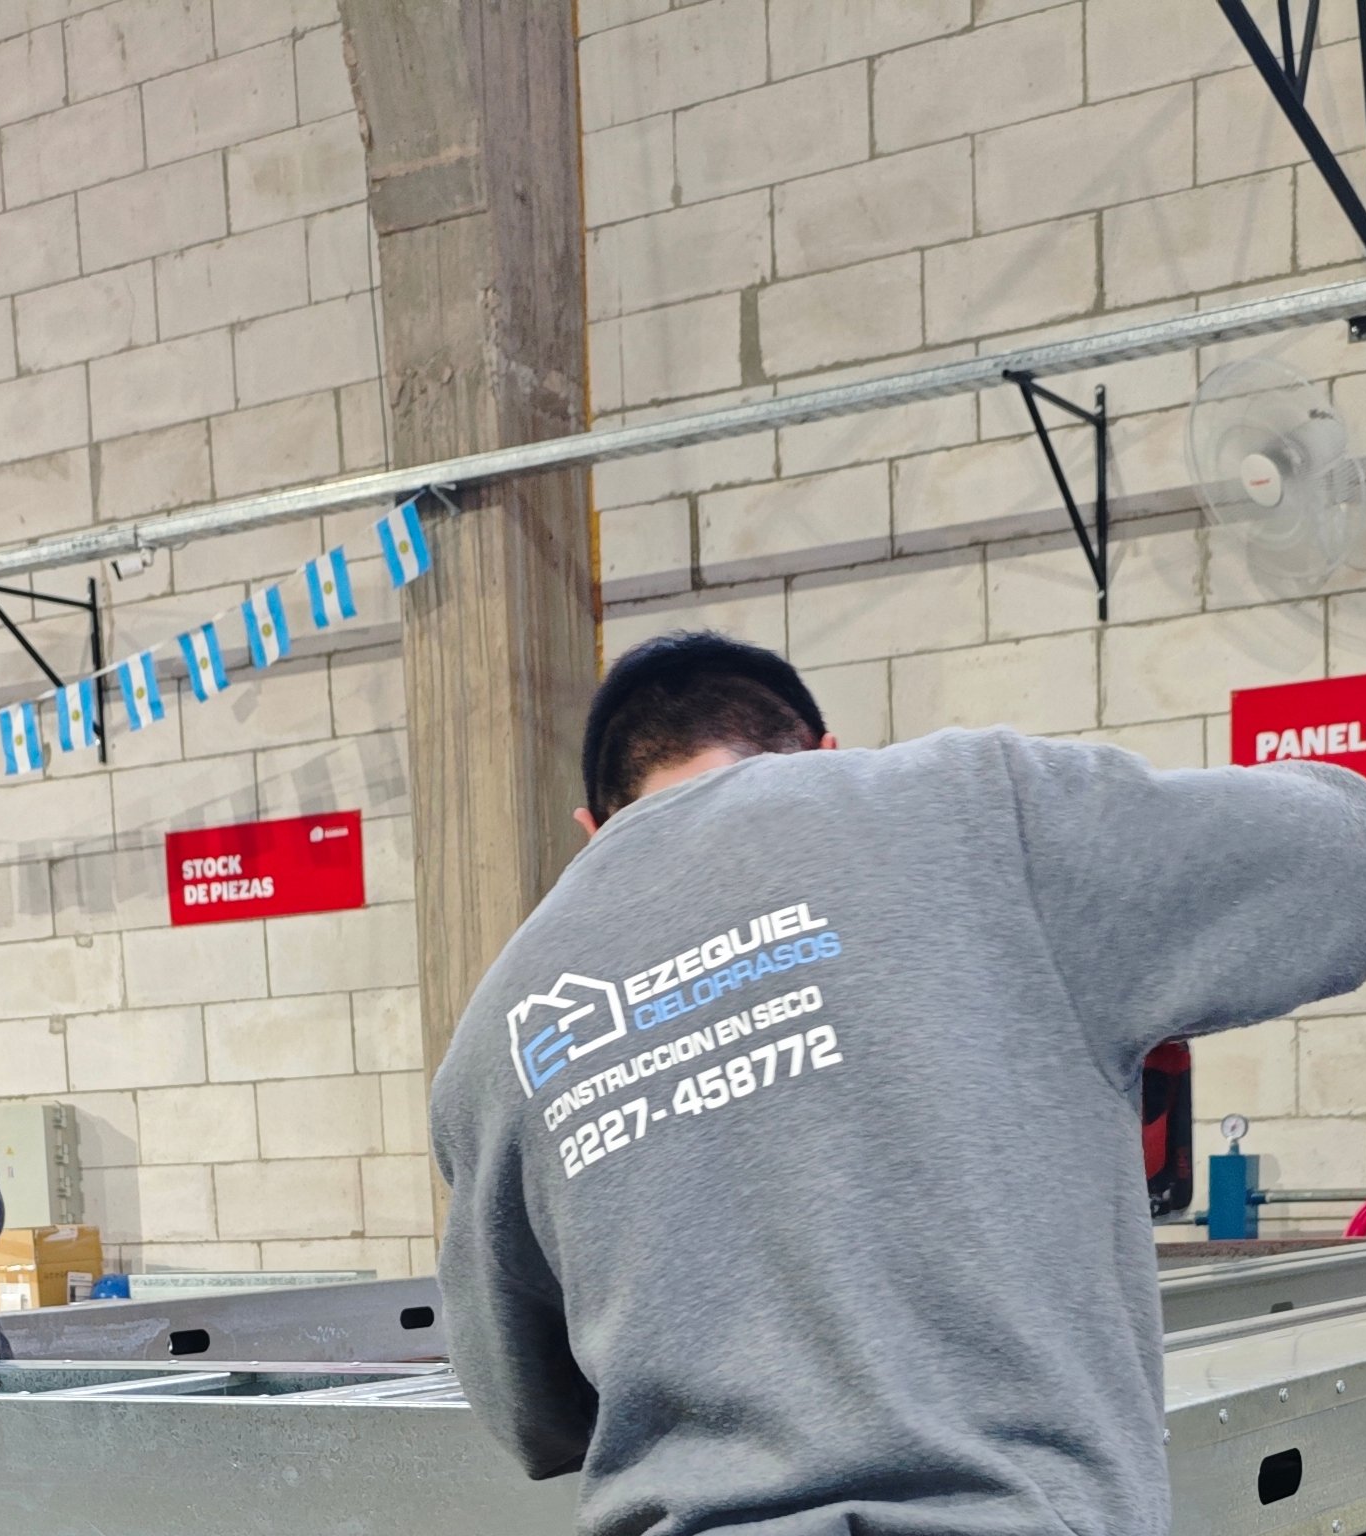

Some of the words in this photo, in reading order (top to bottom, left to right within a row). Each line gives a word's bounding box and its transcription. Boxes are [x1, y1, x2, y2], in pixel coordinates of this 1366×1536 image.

[182, 854, 242, 880] STOCK
[184, 883, 209, 905] DE
[210, 876, 275, 903] PIEZAS
[623, 902, 829, 1006] EZEQUIEL
[634, 930, 843, 1031] CIELORRASOS
[543, 1030, 716, 1132] CONSTRUCCION
[714, 1010, 753, 1046] EN
[752, 985, 824, 1030] SECO
